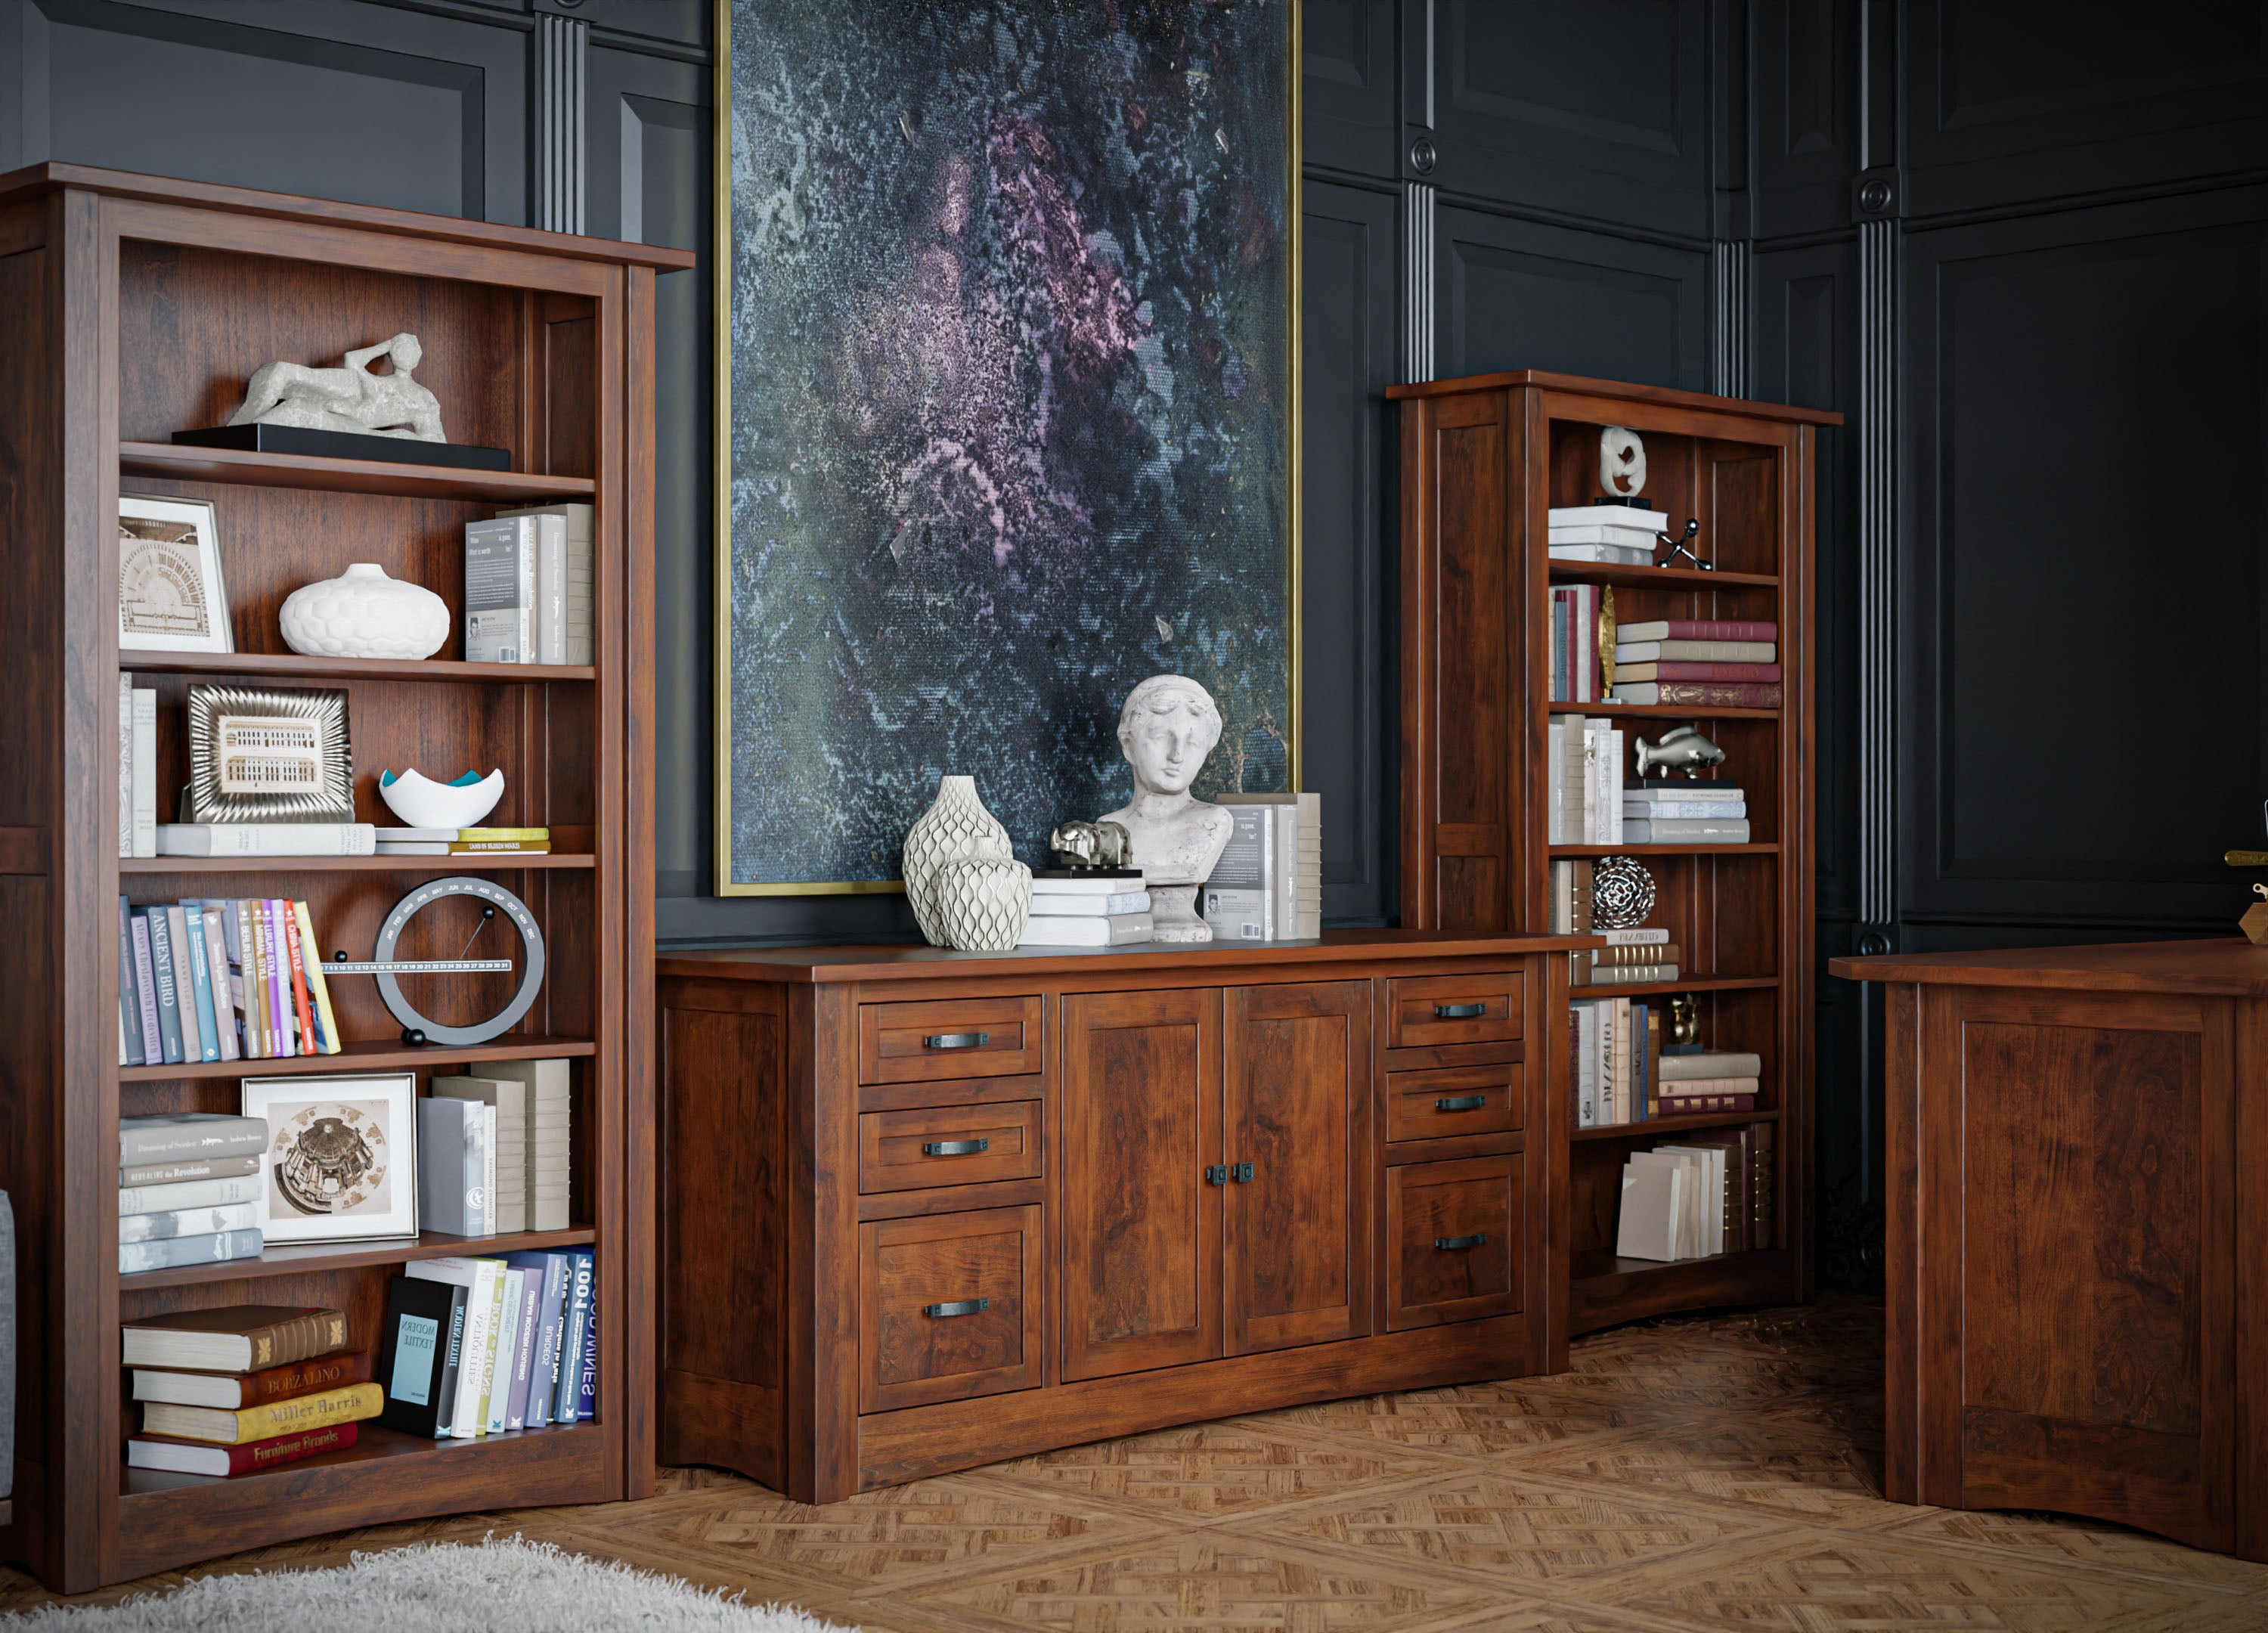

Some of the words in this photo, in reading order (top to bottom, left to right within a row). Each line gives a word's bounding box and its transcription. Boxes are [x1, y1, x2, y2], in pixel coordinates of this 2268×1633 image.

[393, 916, 402, 926] FEB
[403, 902, 414, 914] MAR
[417, 893, 427, 903] APR
[432, 886, 443, 895] MAY
[479, 886, 490, 895] AUG
[494, 893, 505, 901] SEP
[507, 901, 518, 912] OCT
[518, 913, 528, 925] NOV
[526, 928, 535, 940] DEC
[153, 915, 171, 975] ANCIENT
[240, 925, 249, 951] BERLIN
[264, 925, 273, 953] LUXURY
[287, 925, 297, 948] CHINA
[292, 949, 302, 971] STYLE
[243, 953, 253, 977] STYLE
[257, 958, 267, 981] STYLE
[266, 955, 276, 978] STYLE
[279, 966, 288, 987] STYLE
[160, 976, 175, 1007] BIRD
[131, 1170, 164, 1182] REVEALING
[174, 1166, 210, 1177] Revolution
[268, 1366, 339, 1393] BORZALINO
[271, 1404, 314, 1422] Miller
[317, 1395, 362, 1414] Harris
[254, 1440, 300, 1461] Furniture
[303, 1430, 339, 1449] Brands
